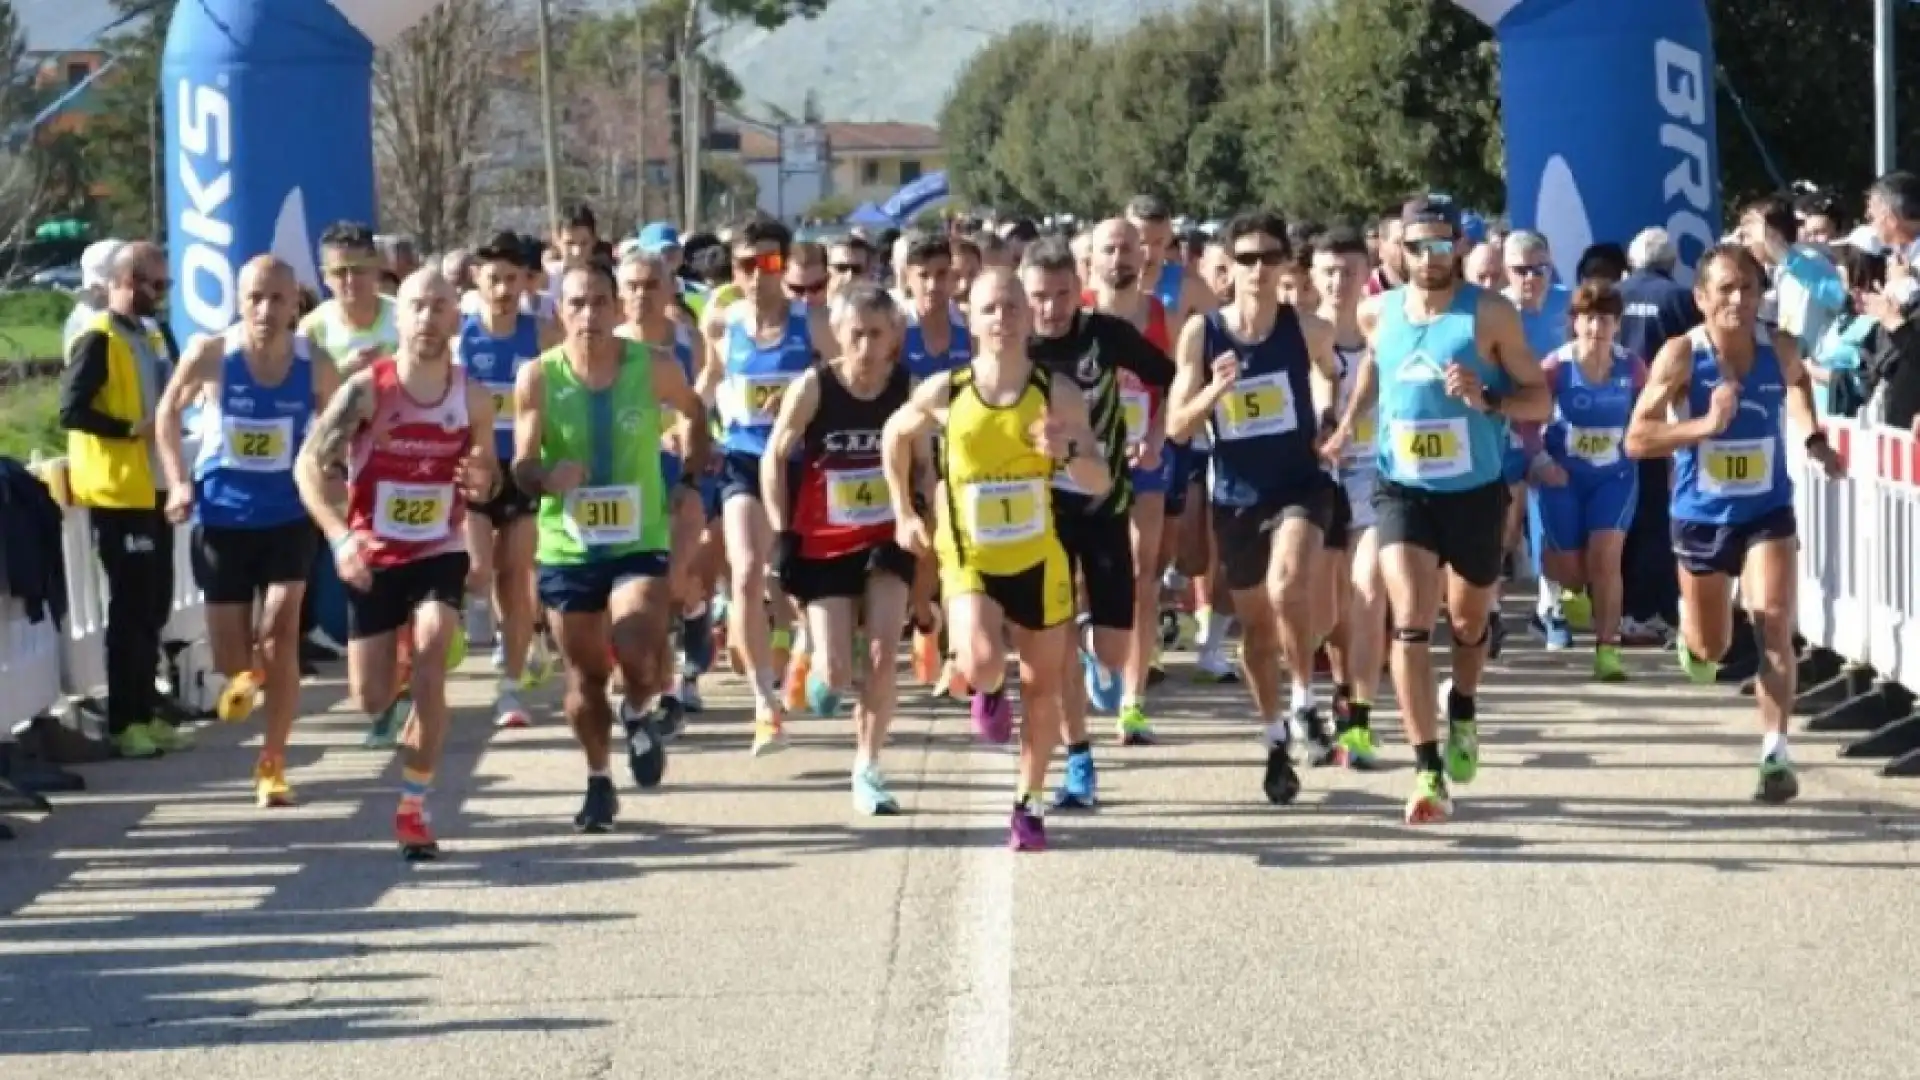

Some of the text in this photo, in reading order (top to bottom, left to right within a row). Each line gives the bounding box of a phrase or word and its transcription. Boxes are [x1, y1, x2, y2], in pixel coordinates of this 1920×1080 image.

[178, 77, 237, 343] OKS
[1244, 392, 1260, 418] 5
[243, 433, 271, 456] 22
[1410, 433, 1442, 458] 40
[1725, 455, 1748, 479] 10
[856, 481, 872, 506] 4
[393, 499, 437, 525] 222
[587, 500, 618, 527] 311
[999, 497, 1011, 524] 1
